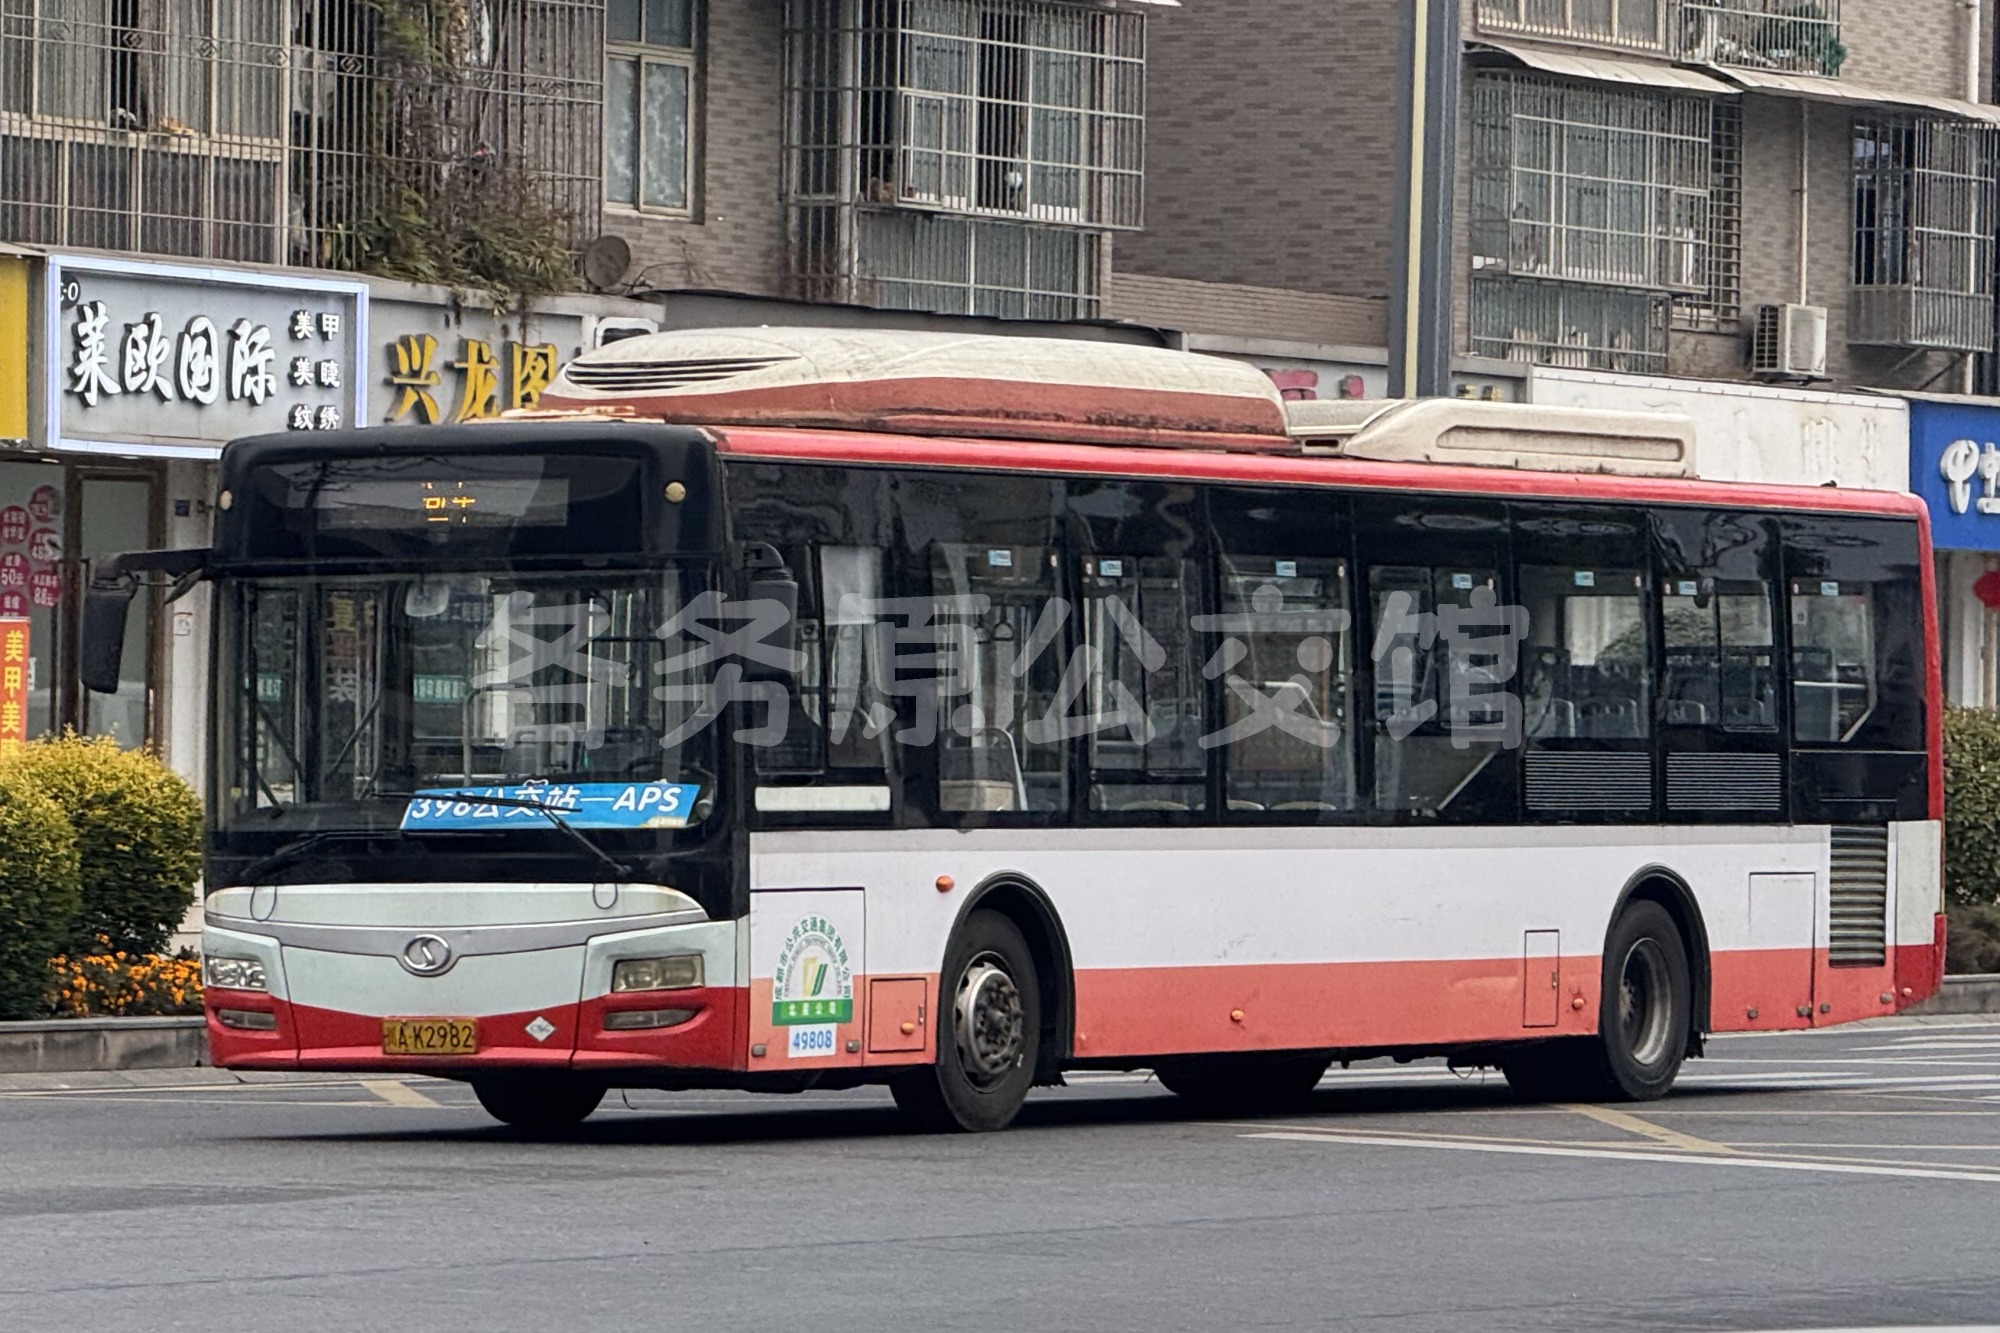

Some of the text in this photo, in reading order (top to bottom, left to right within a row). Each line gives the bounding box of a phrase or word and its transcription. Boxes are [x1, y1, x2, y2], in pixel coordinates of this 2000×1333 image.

[294, 311, 340, 341] 美甲
[72, 300, 277, 406] 莱欧国际
[294, 357, 340, 388] 美睫
[293, 405, 340, 431] 纹绣
[792, 1030, 833, 1050] 49808
